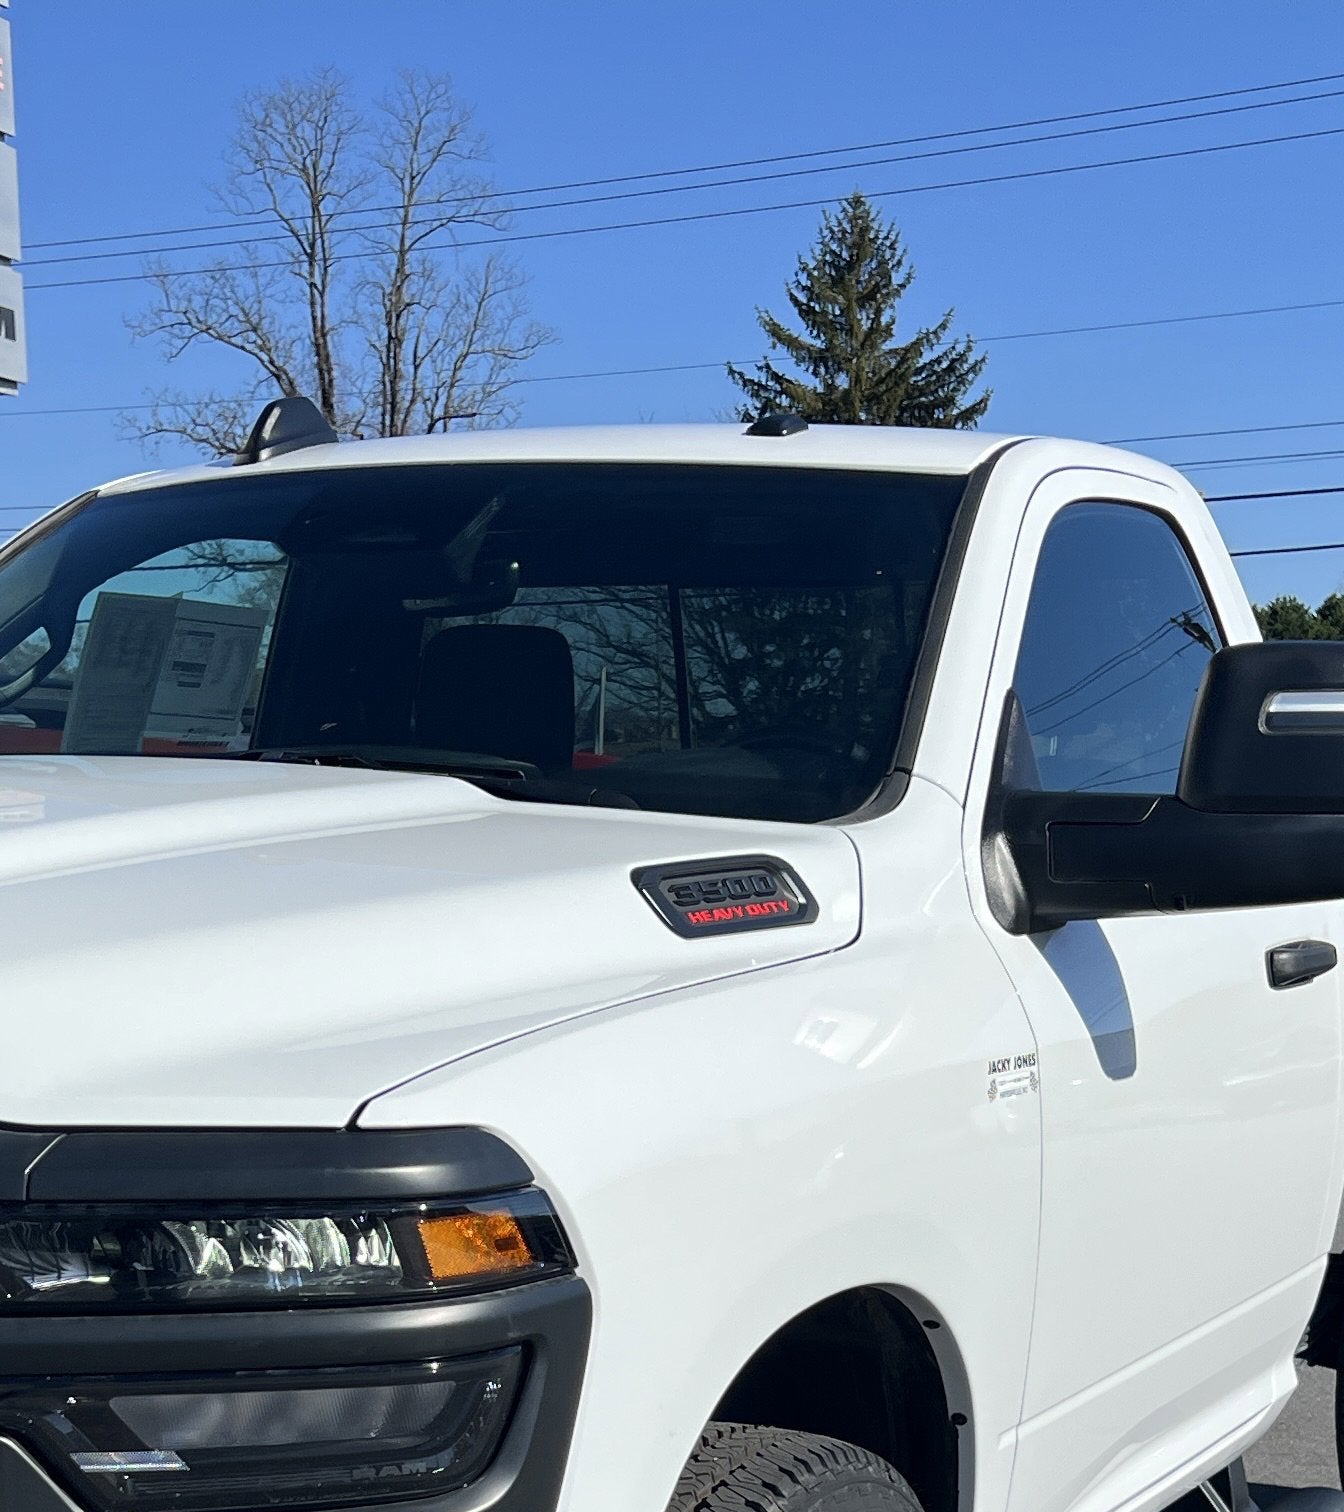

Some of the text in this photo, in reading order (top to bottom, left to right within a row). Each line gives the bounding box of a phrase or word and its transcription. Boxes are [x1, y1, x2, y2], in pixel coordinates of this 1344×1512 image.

[667, 872, 778, 907] 3500
[687, 900, 790, 925] HEAVY DUTY
[987, 1052, 1036, 1076] JACKY JONES
[351, 1462, 427, 1481] RAM
